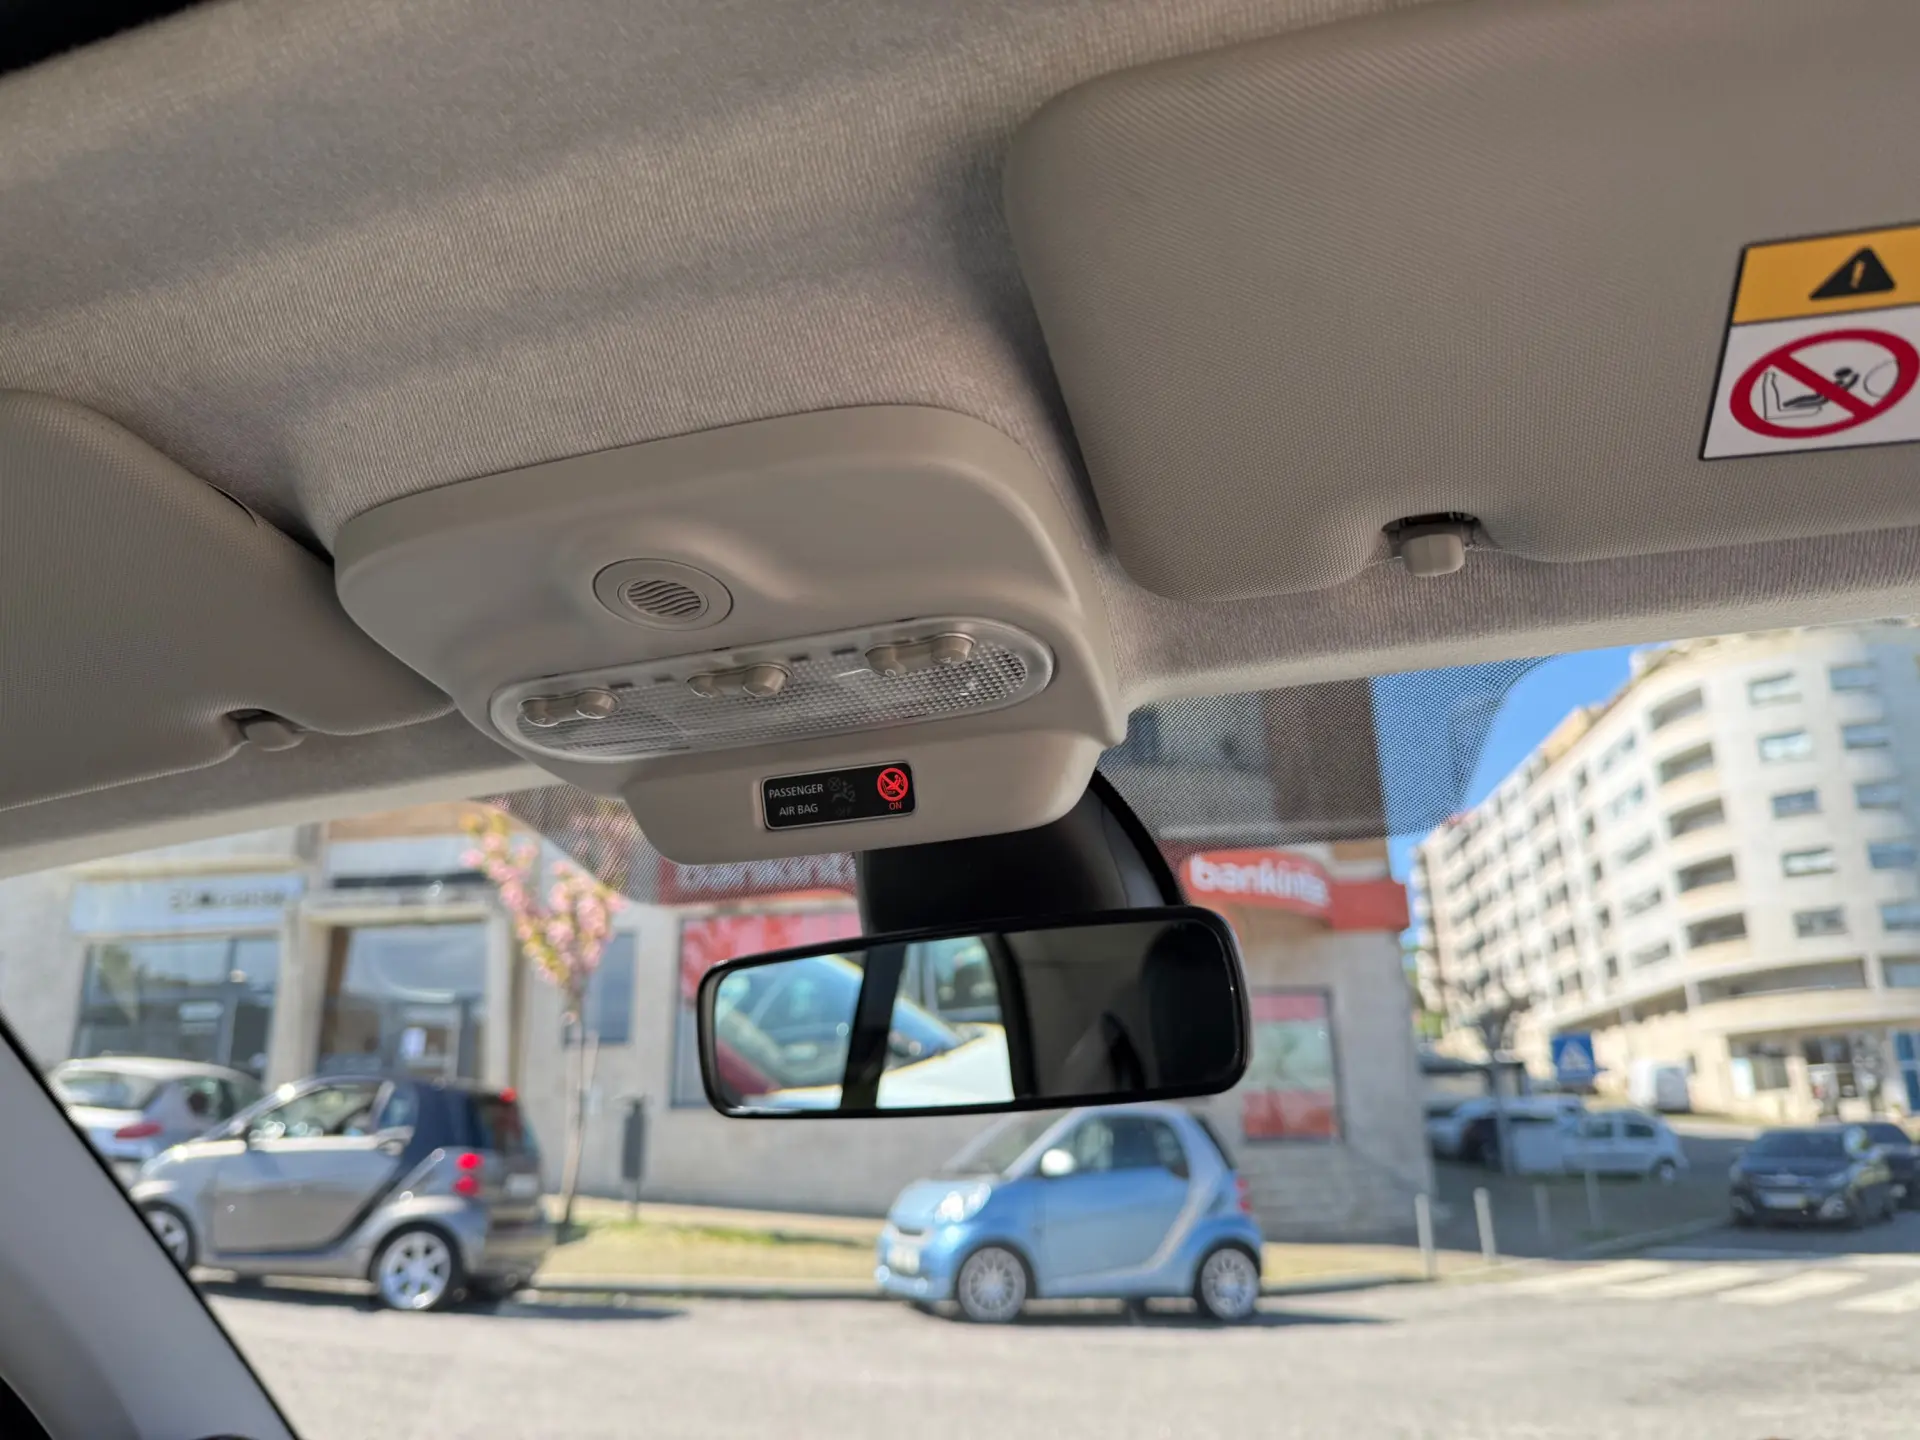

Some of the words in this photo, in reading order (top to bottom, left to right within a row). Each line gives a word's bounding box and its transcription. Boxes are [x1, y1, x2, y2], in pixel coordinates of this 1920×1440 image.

[768, 783, 824, 799] PASSENGER
[779, 805, 796, 817] AIR
[797, 803, 819, 815] BAG
[888, 801, 902, 811] ON
